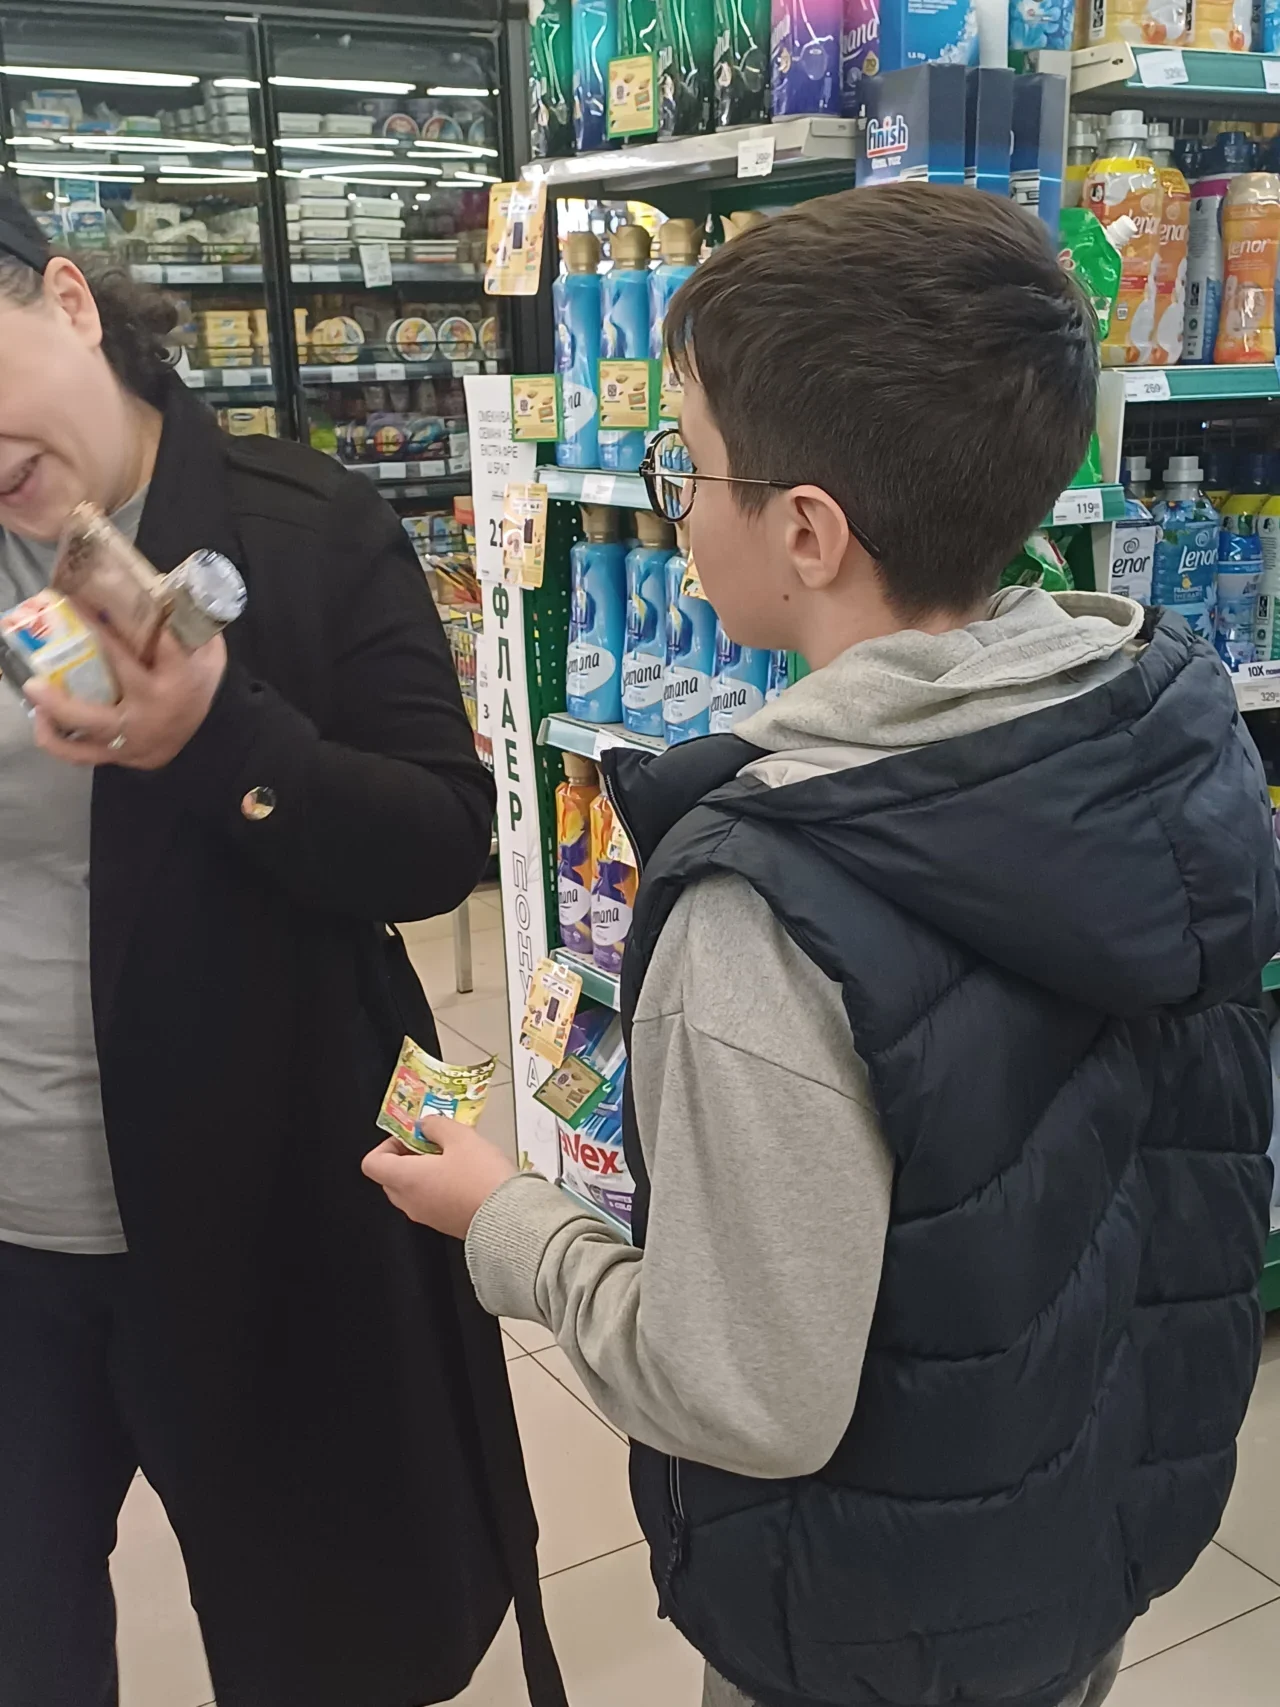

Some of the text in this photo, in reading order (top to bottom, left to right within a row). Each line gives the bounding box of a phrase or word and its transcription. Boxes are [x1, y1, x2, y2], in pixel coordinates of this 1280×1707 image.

[867, 115, 909, 151] finish
[1159, 222, 1187, 246] enor
[1228, 238, 1271, 259] Lenor
[1077, 502, 1094, 514] 119
[1111, 556, 1150, 578] enor
[1178, 546, 1219, 574] Lenor
[567, 652, 600, 675] emana
[1248, 665, 1265, 678] 10X
[663, 676, 699, 701] emana
[711, 688, 747, 712] emana
[1261, 691, 1276, 702] 329
[483, 703, 490, 719] 3
[492, 583, 523, 832] ФЛАЕР
[512, 850, 541, 1090] ПОНУА
